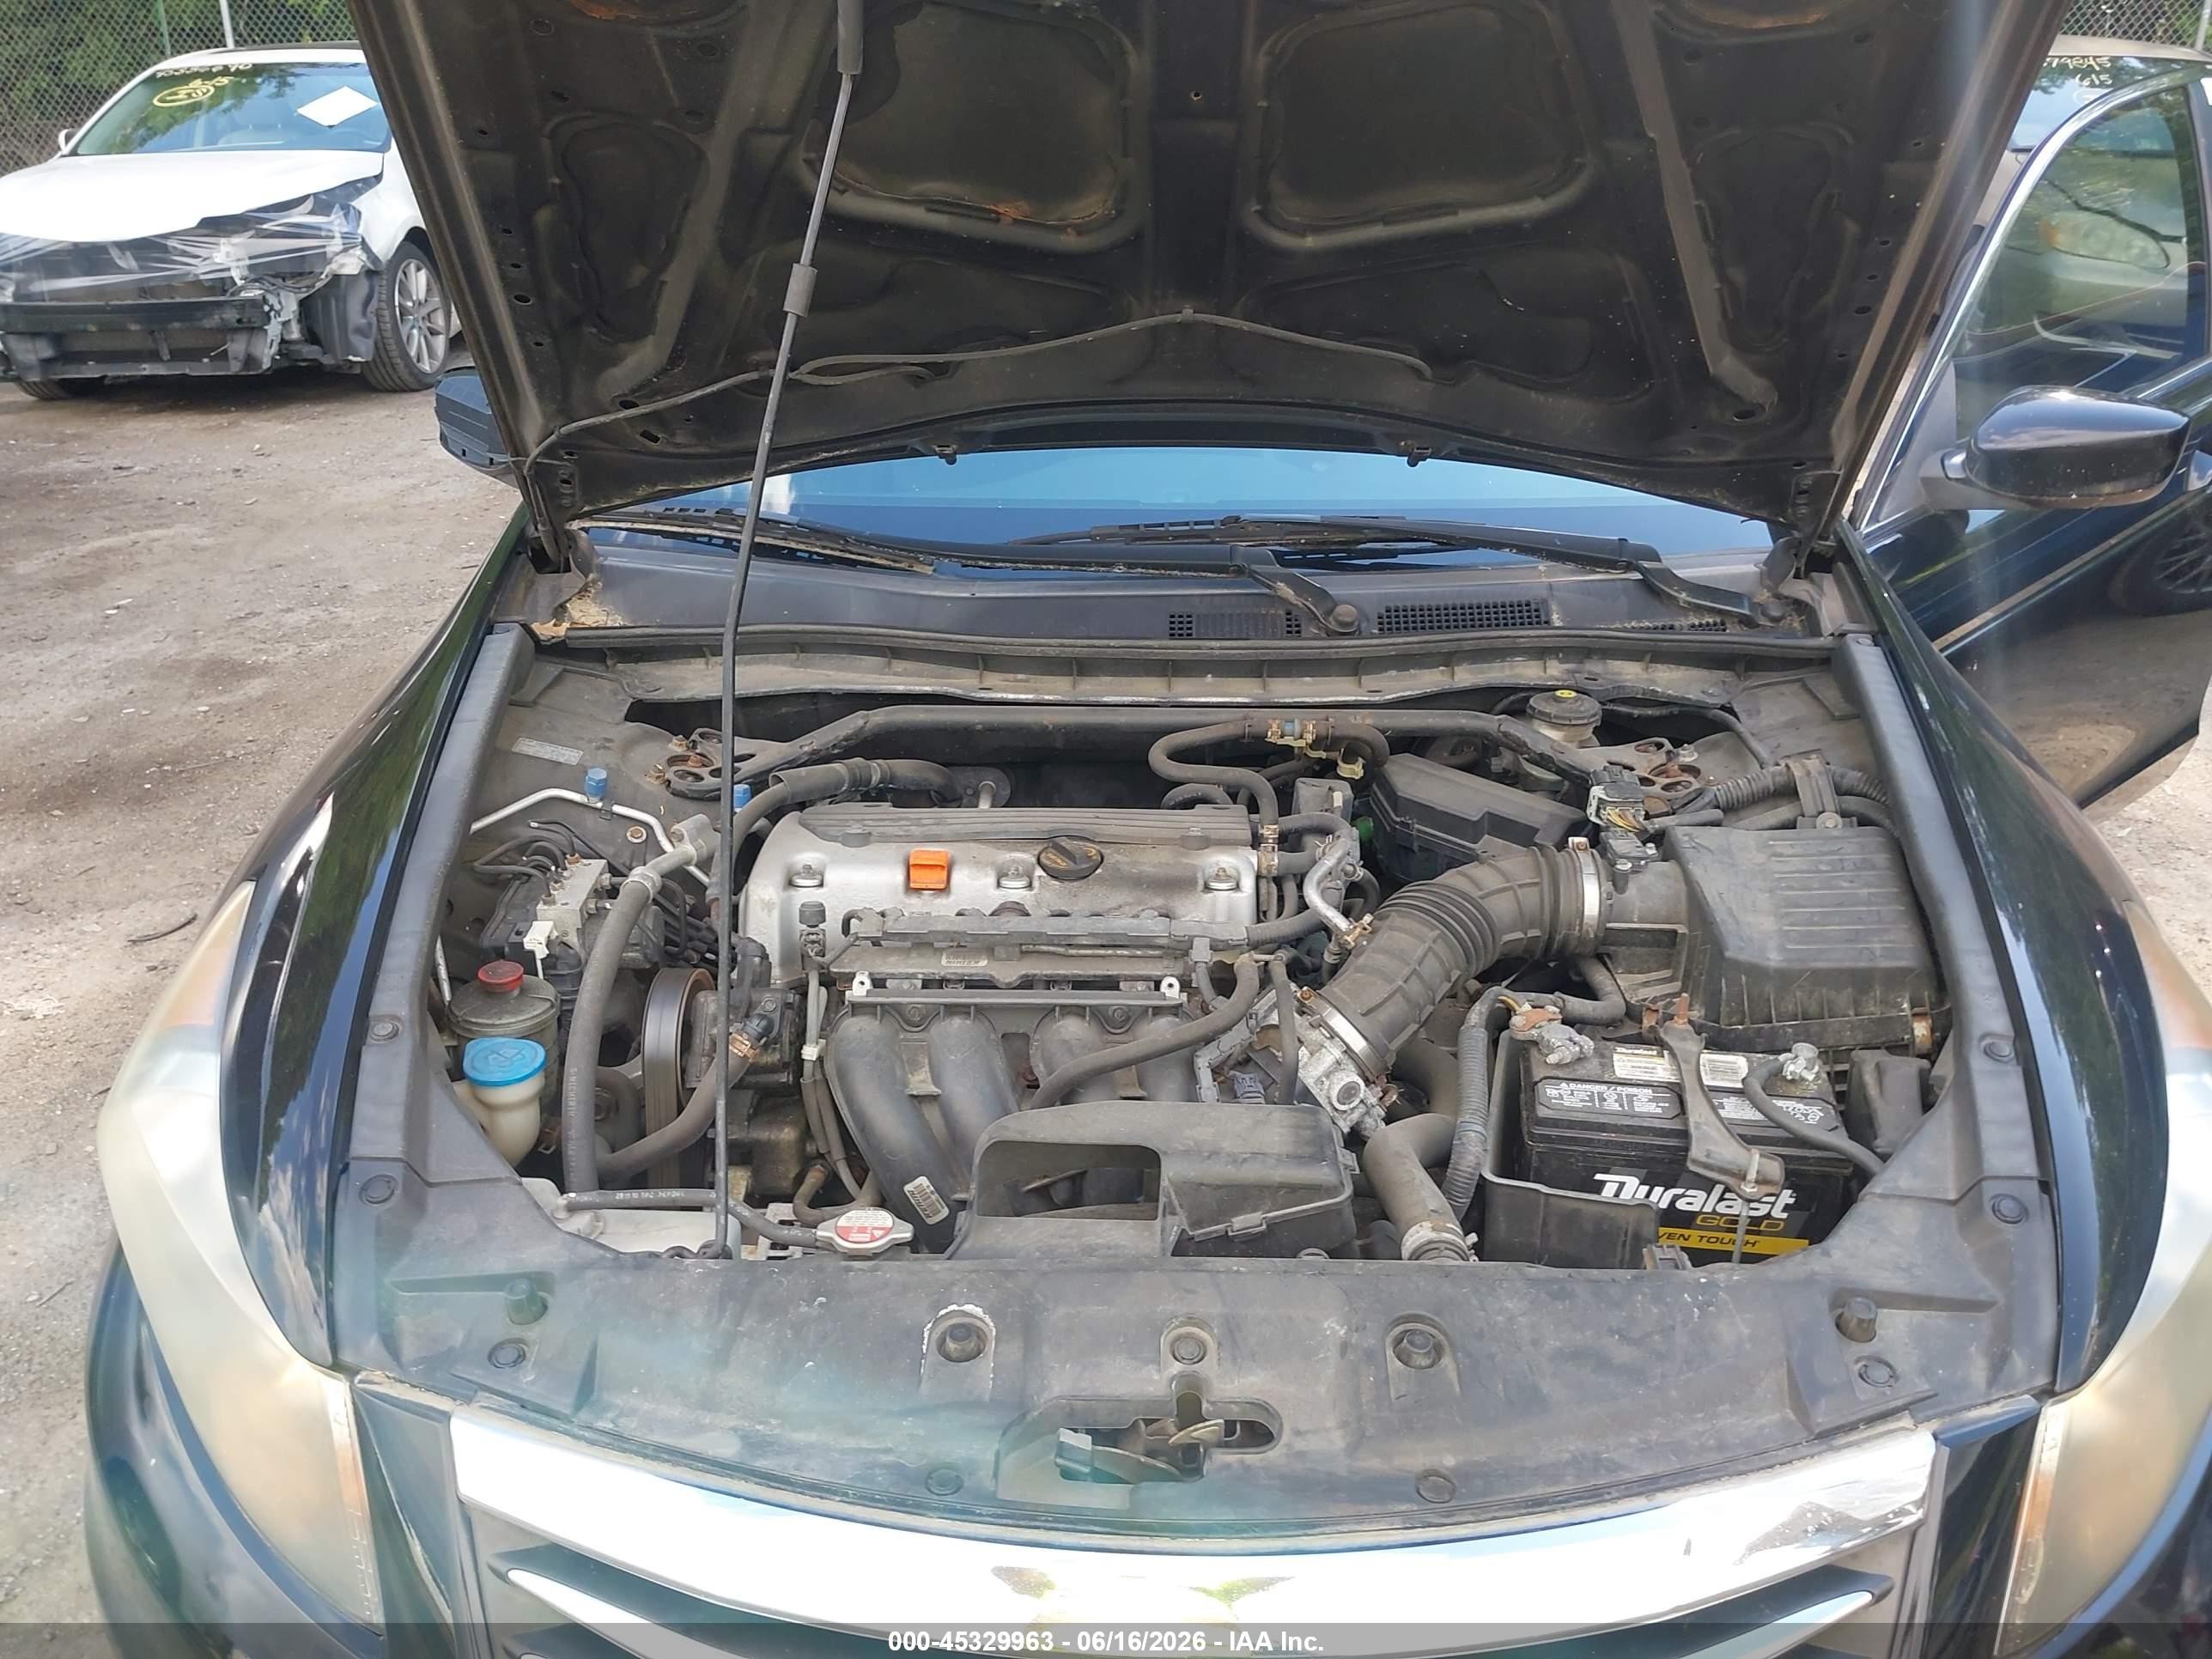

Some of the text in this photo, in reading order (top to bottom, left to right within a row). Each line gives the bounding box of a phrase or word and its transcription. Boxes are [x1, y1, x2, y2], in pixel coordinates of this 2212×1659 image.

[1570, 1083, 1607, 1091] DANGER
[1594, 1173, 1796, 1218] Duralast
[1698, 1235, 1758, 1248] TOUH
